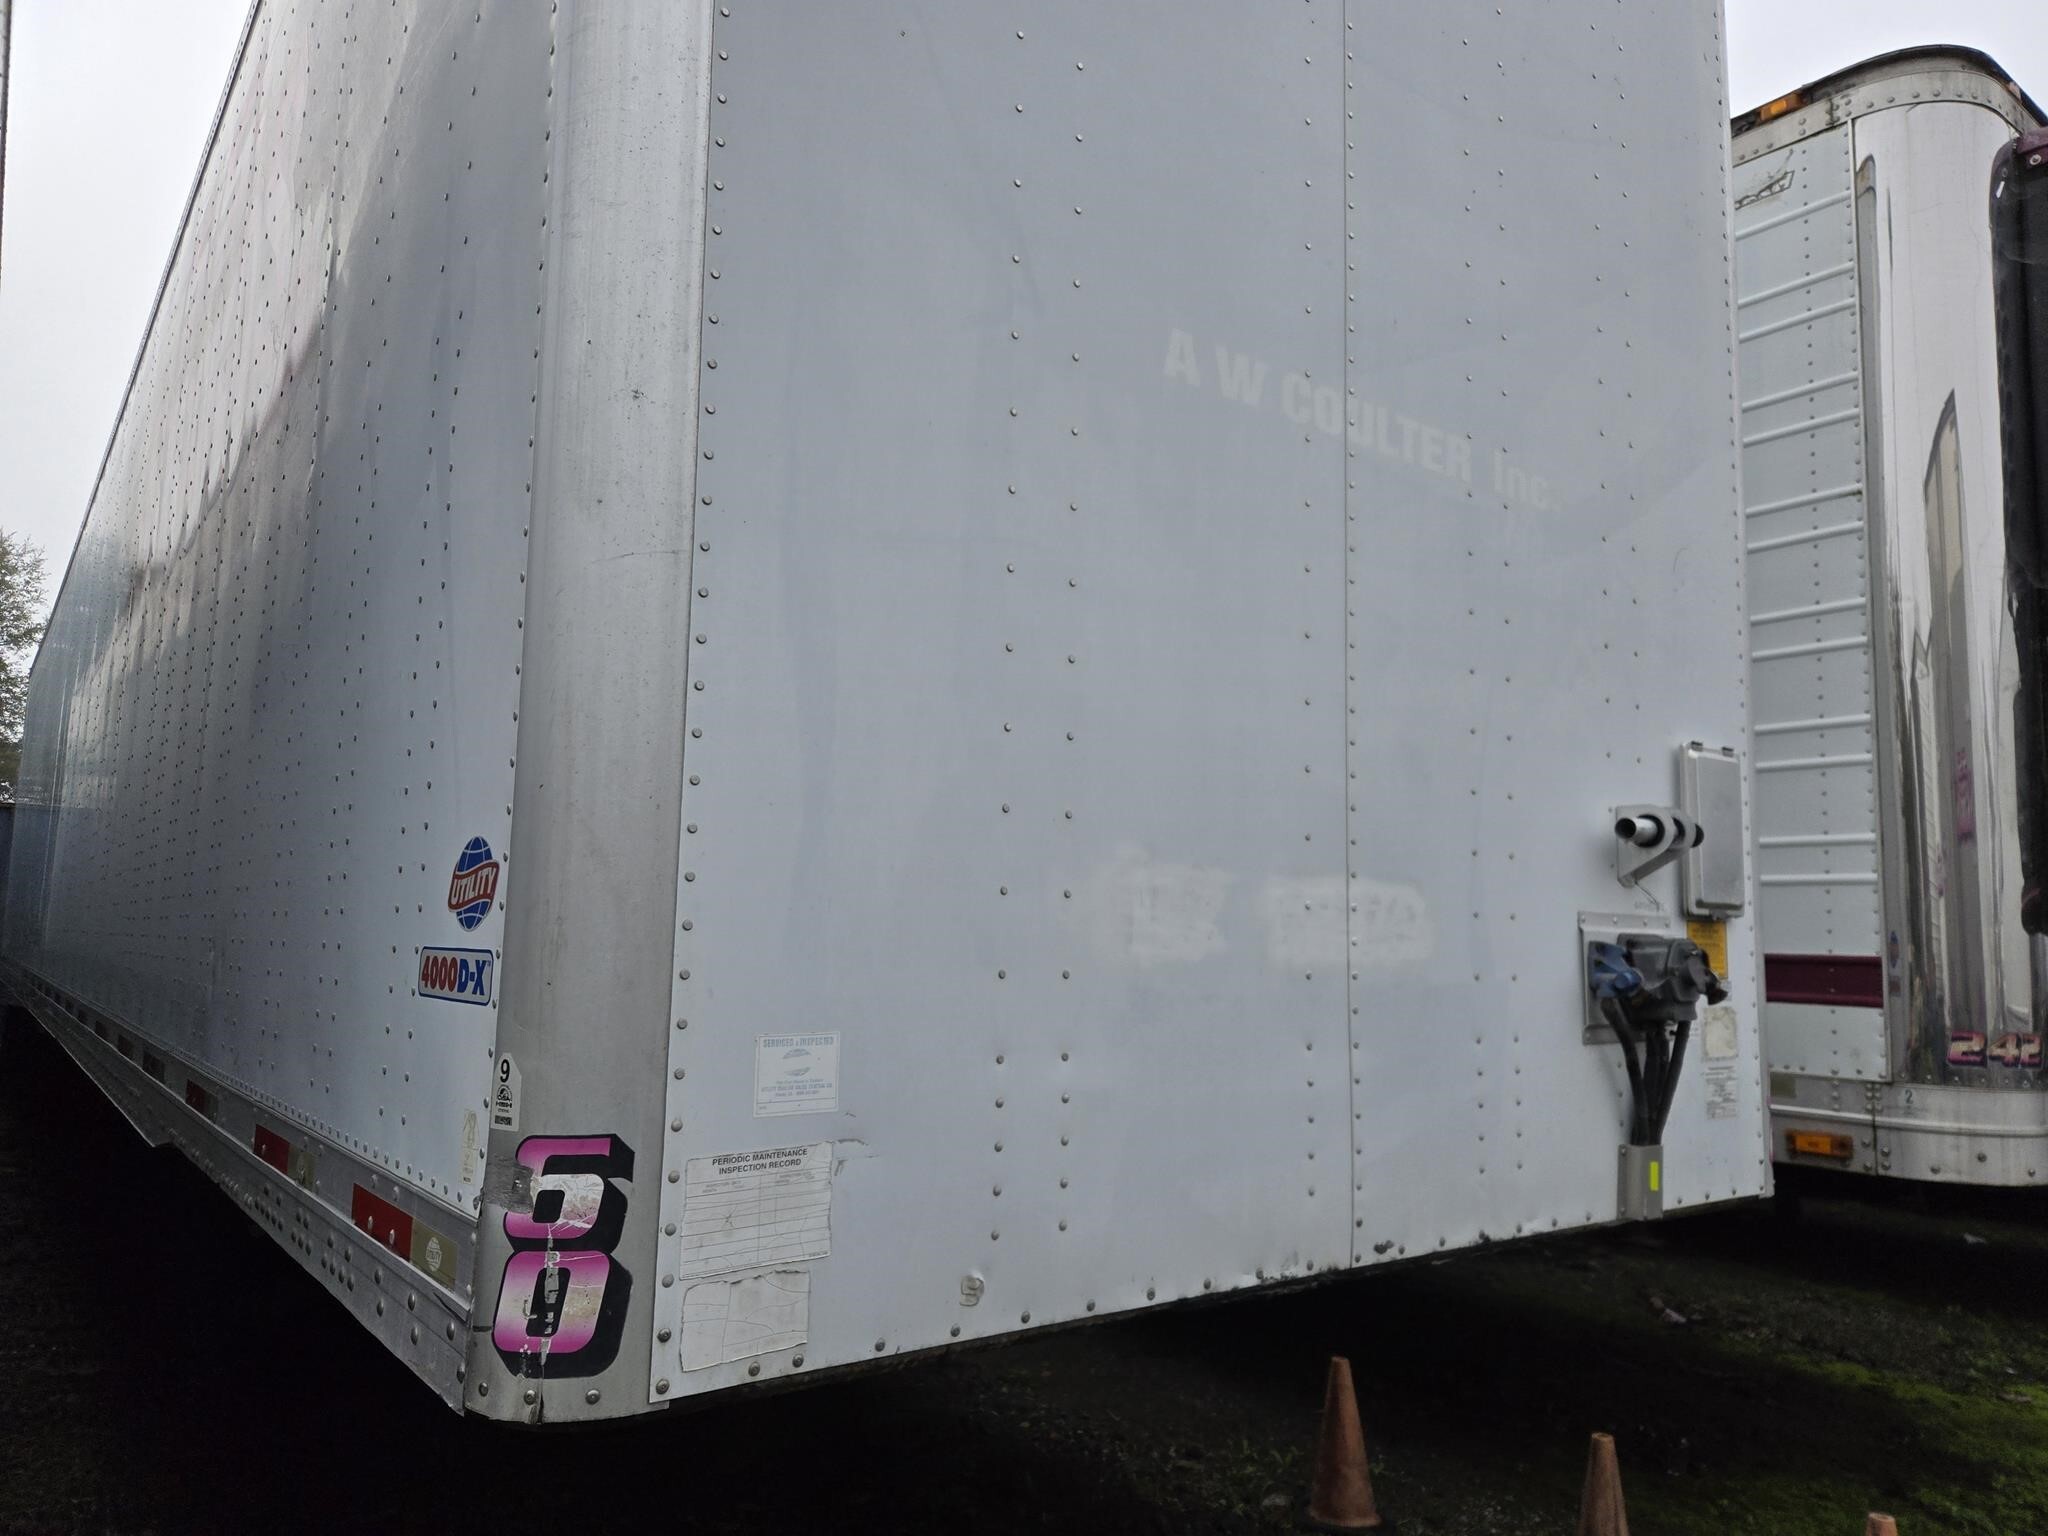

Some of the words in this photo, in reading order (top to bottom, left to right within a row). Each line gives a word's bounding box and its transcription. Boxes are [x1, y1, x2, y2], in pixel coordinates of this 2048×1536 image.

[1164, 328, 1200, 386] A
[1215, 345, 1268, 407] W
[1281, 370, 1472, 484] COULTER
[450, 867, 497, 905] UTILITY
[1947, 1030, 2043, 1067] 242
[500, 1059, 510, 1083] 9
[712, 1154, 751, 1166] PERIODIC
[752, 1148, 808, 1161] MAINTENANCE
[719, 1163, 767, 1175] INSPECTION
[768, 1159, 802, 1169] RECORD
